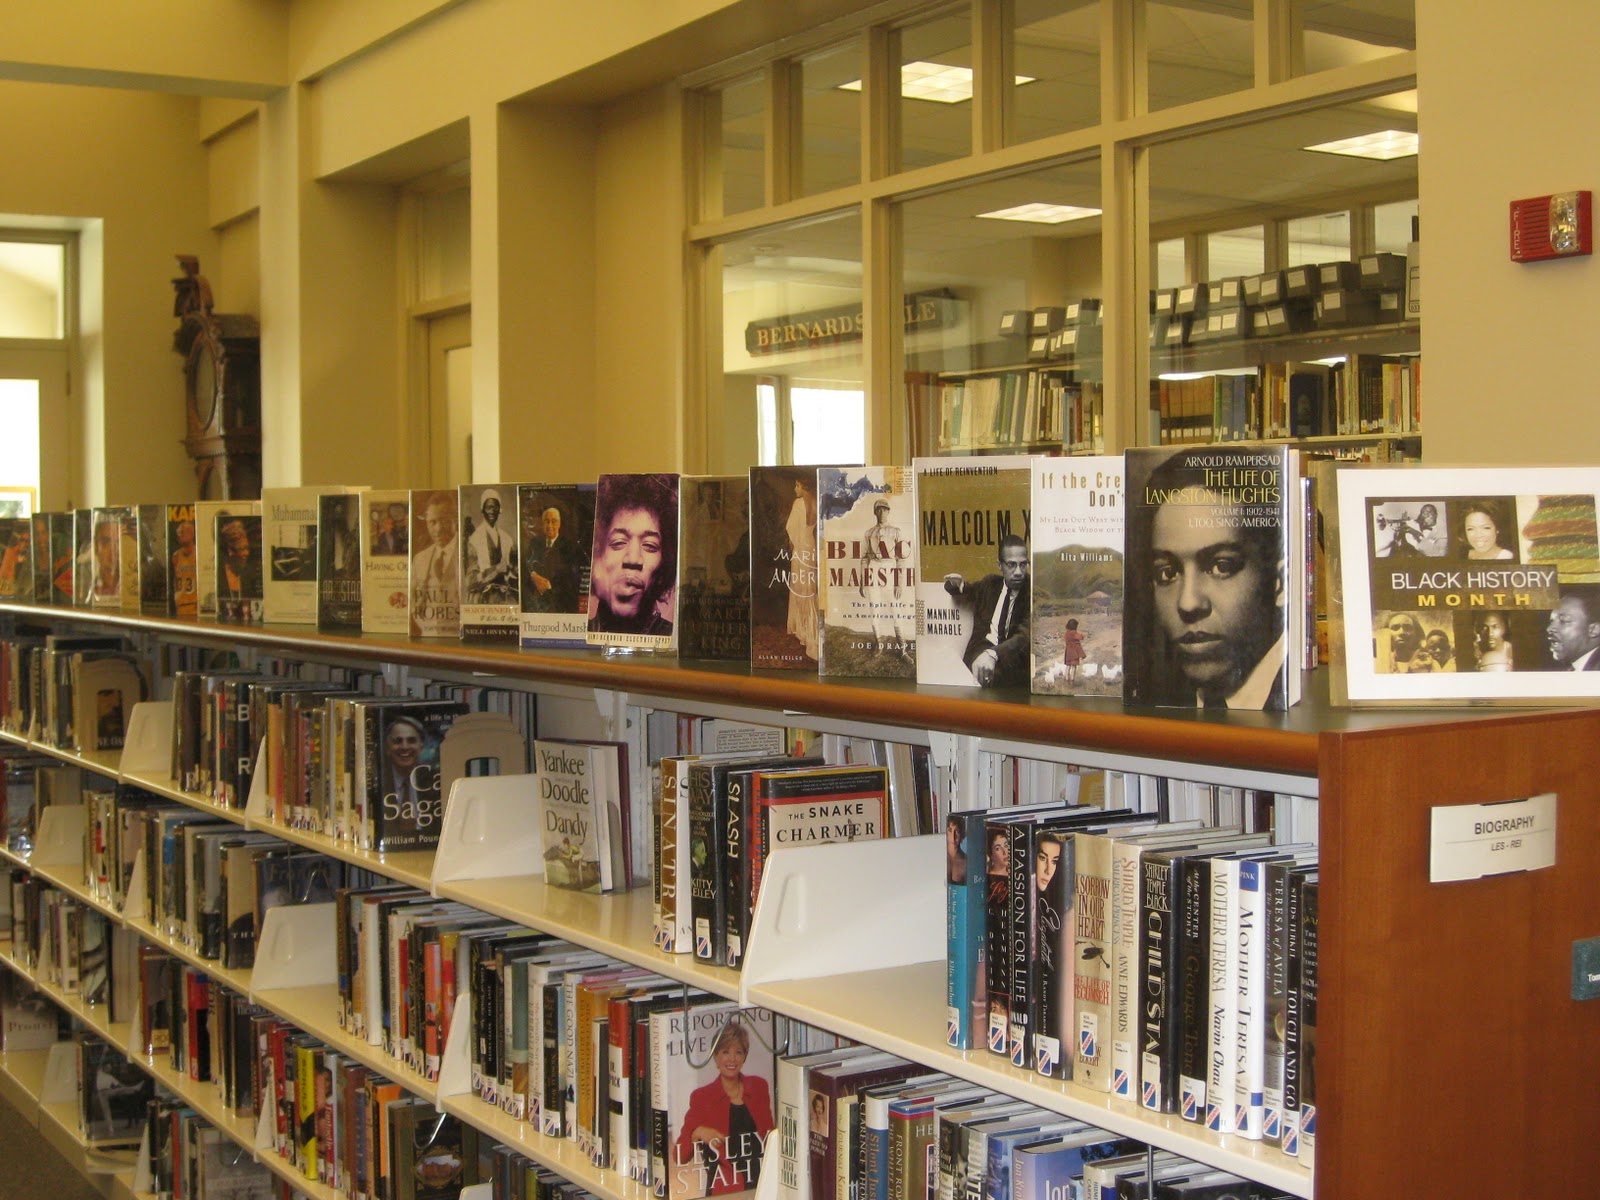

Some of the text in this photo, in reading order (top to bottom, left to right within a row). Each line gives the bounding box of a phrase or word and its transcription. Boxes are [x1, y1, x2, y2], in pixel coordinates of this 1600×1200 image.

[1513, 211, 1521, 250] FIRE
[929, 466, 998, 477] LIFE OF REINVENTION
[1184, 455, 1281, 467] ARNOLD RAMPERSAD
[1041, 473, 1055, 489] If
[1062, 473, 1087, 489] the
[1203, 468, 1280, 487] THE LIFE OF
[1145, 486, 1281, 506] LANGSTON HUGHES
[1211, 507, 1280, 516] VOLUME 1902-1941
[1216, 517, 1281, 528] SING AMERICA
[923, 509, 1011, 546] MALCOLM
[1060, 552, 1113, 562] Rita Williams
[1391, 570, 1555, 590] BLACK HISTORY
[1417, 593, 1531, 607] MONTH
[926, 607, 960, 621] MANNING
[523, 621, 560, 635] Thurgood
[926, 622, 962, 636] MARABLE
[541, 750, 585, 776] Yankee
[541, 777, 589, 805] Doodle
[383, 793, 442, 827] Saga
[727, 782, 740, 858] SLASH
[809, 803, 864, 818] SNAKE
[546, 810, 588, 846] Dandy
[776, 822, 875, 843] CHARMER
[1474, 815, 1535, 835] BIOGRAPHY
[383, 835, 415, 845] William
[661, 775, 676, 921] SINATRA
[1491, 841, 1505, 852] LES
[1121, 858, 1137, 907] SHIRLEY
[1145, 864, 1169, 881] SHIRLEY
[1079, 875, 1111, 899] SORROW
[1146, 878, 1166, 896] TEMPLE
[1078, 894, 1105, 920] IN OUR
[1146, 893, 1168, 910] BLACK
[1289, 887, 1297, 920] STUDS
[1014, 827, 1027, 1003] A PASSION FOR LIFE
[1037, 897, 1061, 971] Elizabeth
[1078, 915, 1105, 941] HEART
[1273, 878, 1283, 996] TERESA of AVILA
[1147, 911, 1163, 996] CHILD
[1238, 906, 1254, 997] MOTHER
[1303, 939, 1317, 947] LIFE
[1118, 953, 1128, 981] ANNE
[1212, 871, 1228, 1046] MOTHER TERESA Navin
[1101, 979, 1111, 990] OF
[1118, 984, 1128, 1033] EDWARDS
[1287, 987, 1298, 1042] TOUCH
[565, 983, 574, 1079] THE GOOD NAZI
[670, 1010, 772, 1034] REPORTING
[1146, 1001, 1161, 1052] STA
[669, 1037, 707, 1056] LIVE
[1237, 1006, 1252, 1075] TERESA
[1286, 1049, 1297, 1080] AND
[652, 1084, 661, 1107] LIVE
[1285, 1085, 1296, 1108] GO
[653, 1110, 661, 1146] LESLEY
[782, 1116, 798, 1138] IRON
[676, 1130, 770, 1168] LESLEY
[781, 1135, 797, 1159] LADY
[869, 1133, 880, 1173] Silent
[895, 1134, 903, 1174] FRONT
[676, 1160, 764, 1194] STAH
[1015, 1158, 1024, 1176] Jon
